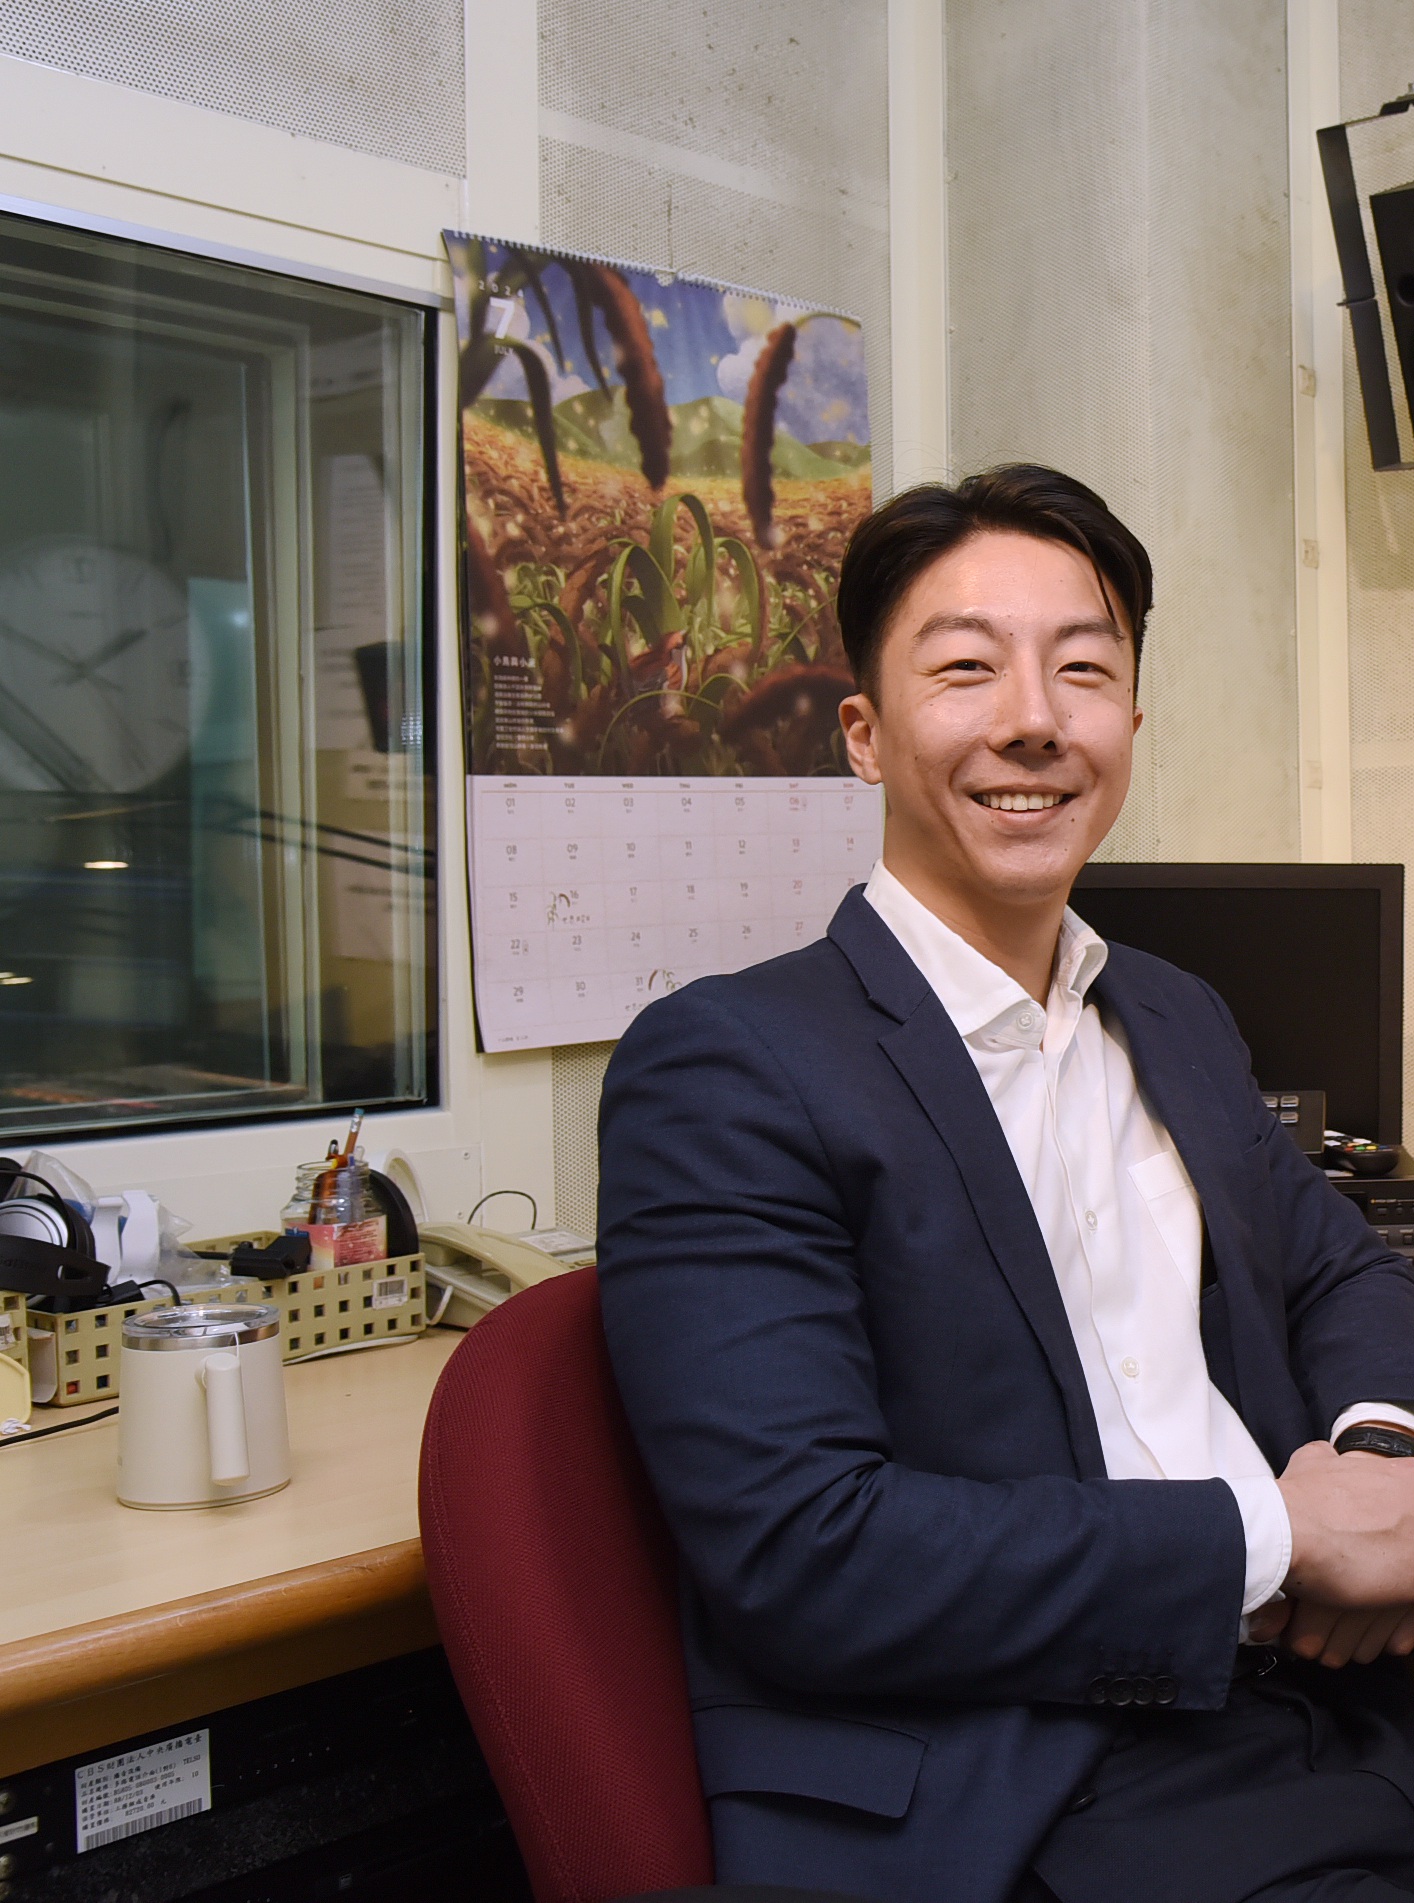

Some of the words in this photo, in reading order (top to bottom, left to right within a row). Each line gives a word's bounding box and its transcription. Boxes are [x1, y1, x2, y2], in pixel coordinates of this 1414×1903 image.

[489, 297, 515, 339] 7
[505, 798, 515, 807] 01
[565, 798, 575, 807] 02
[623, 798, 634, 807] 03
[681, 797, 692, 806] 04
[735, 797, 745, 807] 05
[506, 845, 517, 855] 08
[567, 844, 578, 853] 09
[626, 843, 636, 852] 10
[685, 841, 692, 850] 11
[738, 840, 746, 849] 12
[792, 838, 800, 848] 13
[846, 837, 854, 846] 14
[509, 892, 518, 902] 15
[570, 890, 579, 900] 16
[630, 887, 637, 896] 17
[687, 885, 695, 894] 18
[740, 882, 748, 892] 19
[793, 880, 803, 889] 20
[511, 939, 521, 949] 22
[572, 935, 582, 945] 23
[631, 932, 640, 941] 24
[689, 928, 698, 938] 25
[742, 926, 751, 935] 26
[795, 922, 803, 931] 27
[513, 986, 524, 996] 29
[576, 981, 586, 991] 30
[635, 976, 643, 986] 31
